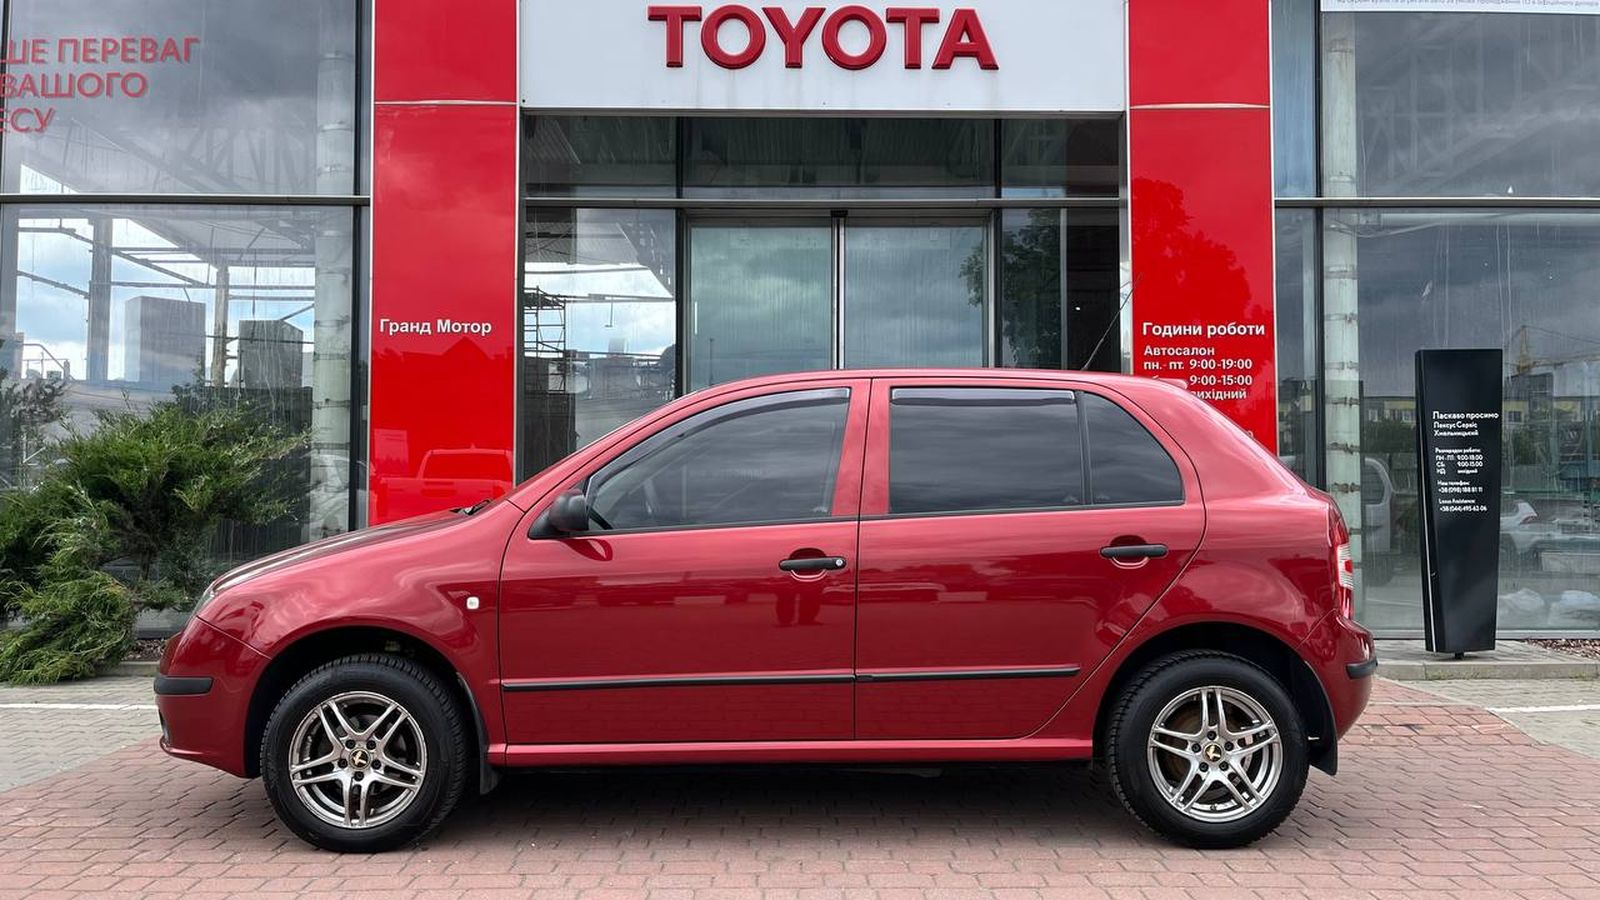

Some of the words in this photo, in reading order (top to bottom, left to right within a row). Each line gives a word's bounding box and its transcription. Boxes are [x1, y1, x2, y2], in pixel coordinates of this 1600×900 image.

[648, 4, 999, 70] TOYOTA
[57, 37, 200, 63] ПЕРЕВАГ
[0, 72, 148, 98] ВАШОГО
[379, 318, 432, 336] Гранд
[436, 318, 493, 336] Мотор
[1142, 322, 1202, 337] Години
[1207, 322, 1265, 338] роботи
[1143, 345, 1215, 356] Автосалон
[1466, 412, 1499, 421] просимо
